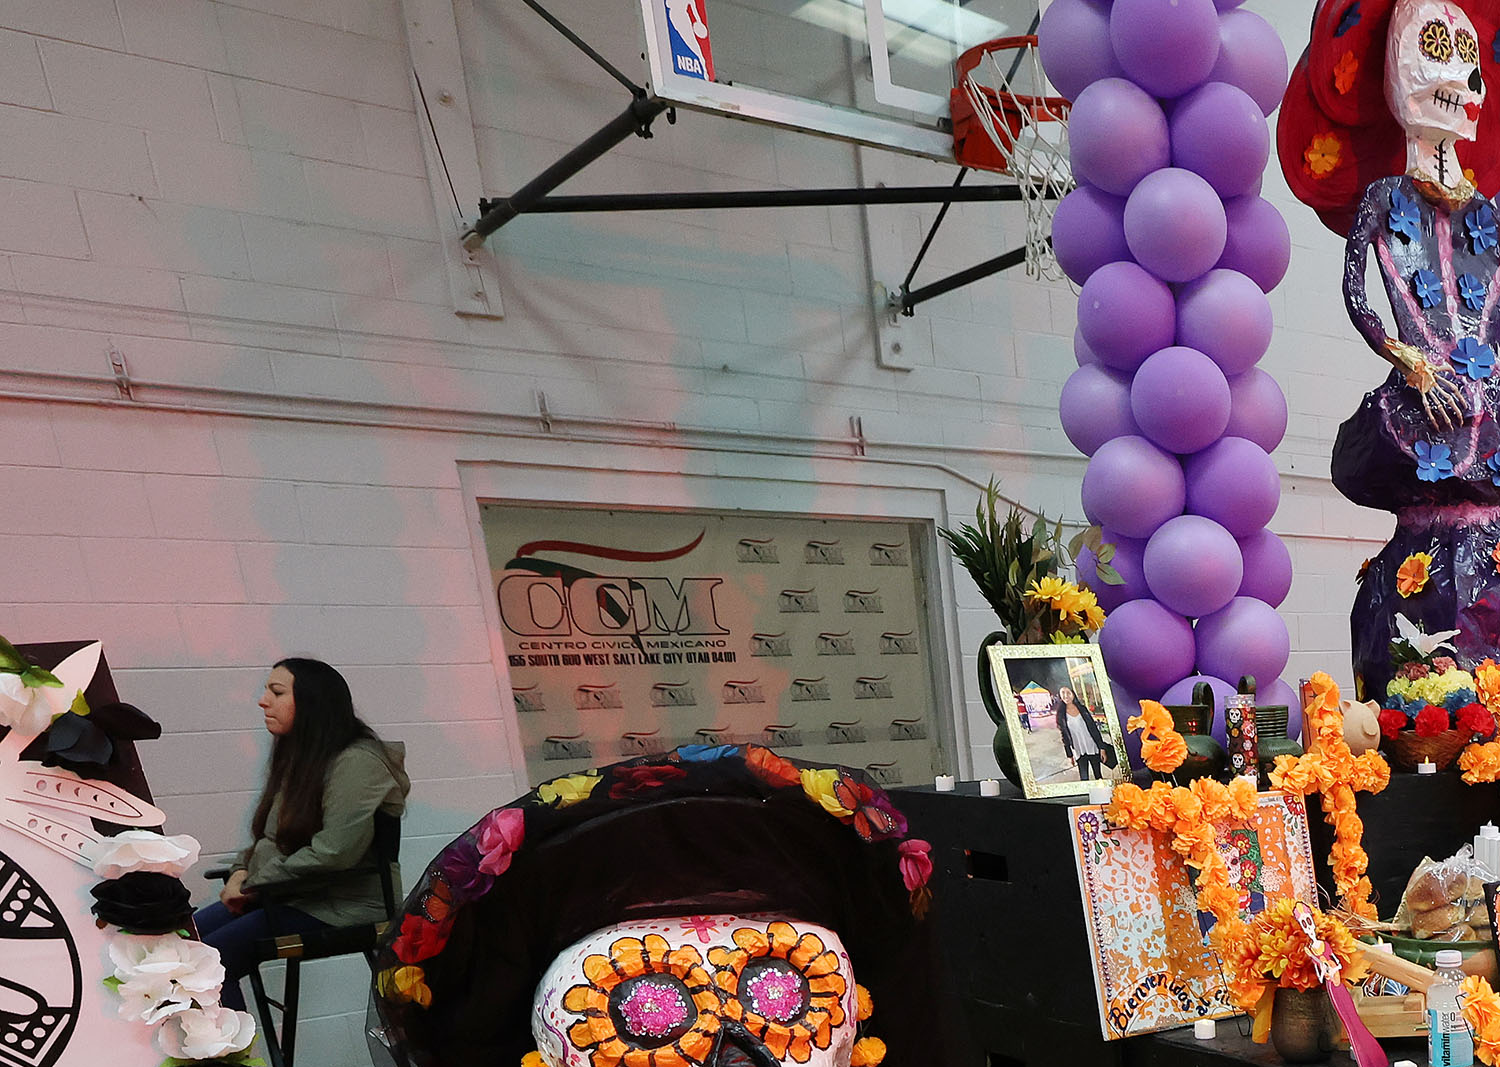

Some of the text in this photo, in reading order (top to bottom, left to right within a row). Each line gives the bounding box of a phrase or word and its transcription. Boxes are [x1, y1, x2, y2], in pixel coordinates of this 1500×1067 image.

[676, 54, 703, 75] NBA
[497, 574, 731, 636] CCM
[519, 640, 727, 650] CENTRO CIVICO MEXICANO
[528, 654, 560, 667] SOUTH
[583, 653, 610, 666] WEST
[613, 653, 636, 665] SALT
[638, 652, 661, 665] LAKE
[663, 652, 683, 664] CITY
[686, 652, 710, 664] UTAH
[1109, 972, 1193, 1037] Bienvenidos
